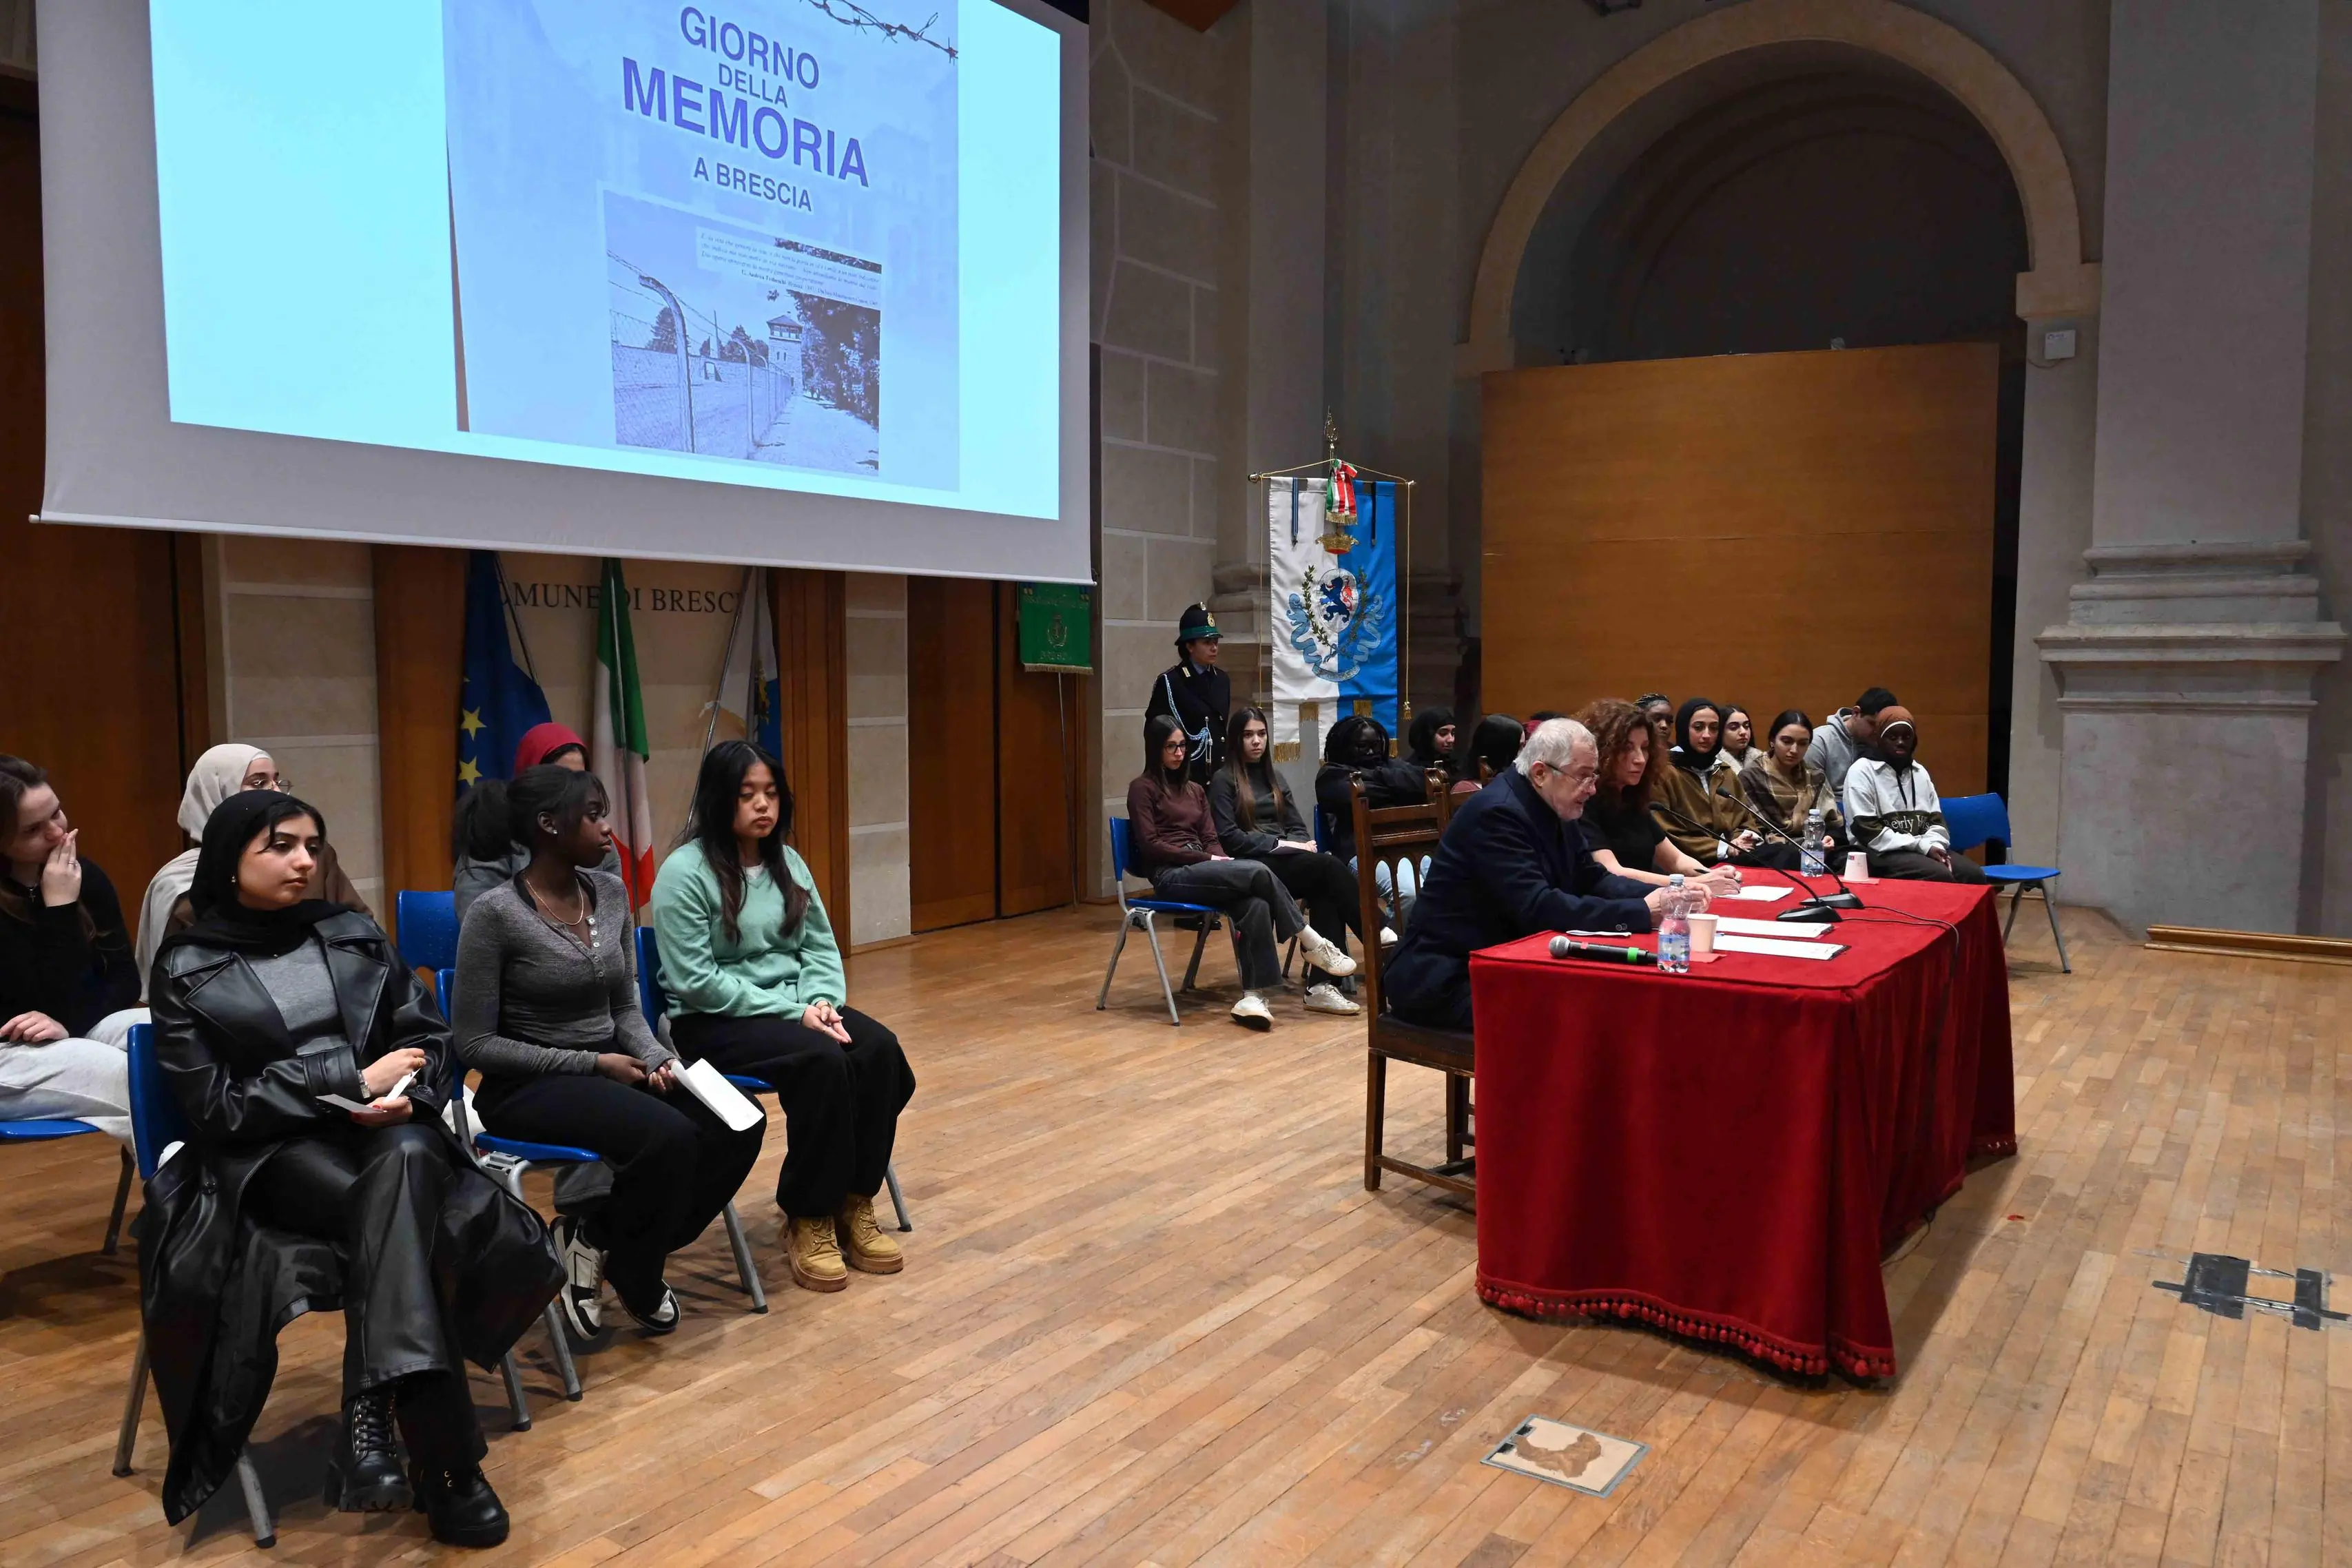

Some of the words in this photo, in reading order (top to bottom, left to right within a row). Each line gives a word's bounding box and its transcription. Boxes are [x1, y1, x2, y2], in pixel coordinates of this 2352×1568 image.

[680, 6, 820, 90] GIORNO
[719, 63, 788, 108] DELLA
[623, 56, 869, 187] MEMORIA
[694, 156, 710, 181] A
[716, 163, 812, 212] BRESCIA
[501, 581, 601, 609] MUNE
[651, 588, 740, 614] BRESC
